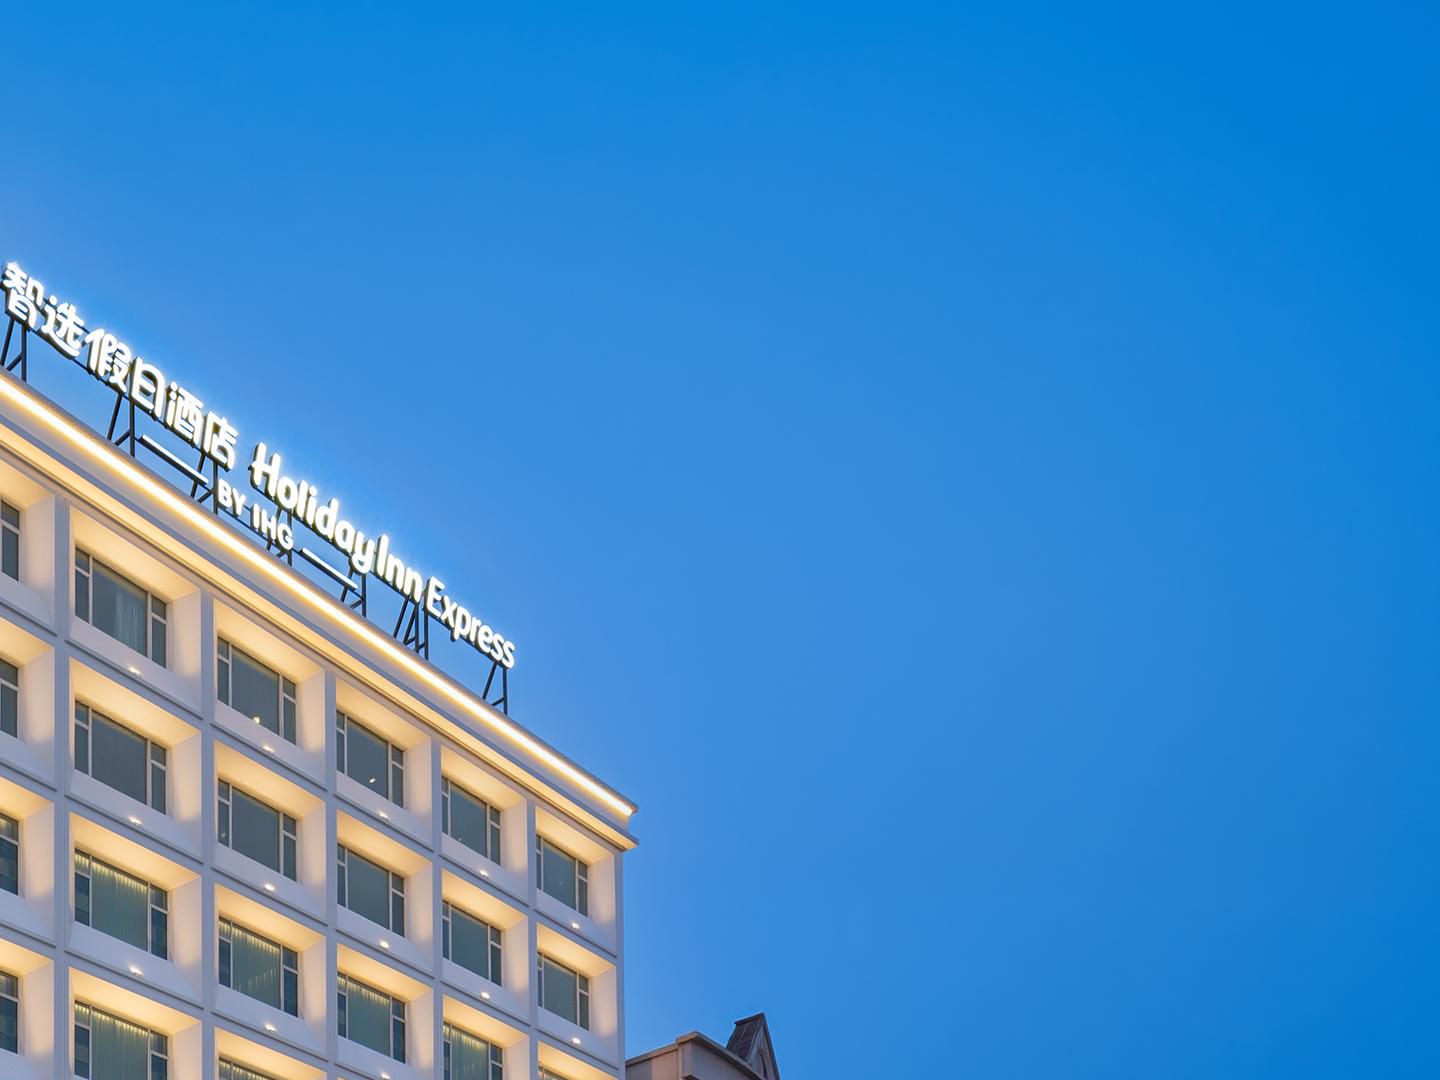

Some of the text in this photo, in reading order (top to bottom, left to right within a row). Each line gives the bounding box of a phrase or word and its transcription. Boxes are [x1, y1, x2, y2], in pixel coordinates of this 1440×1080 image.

[0, 261, 515, 669] 智选假日酒店 Holiday Inn Express
[217, 478, 294, 551] BY IHG
